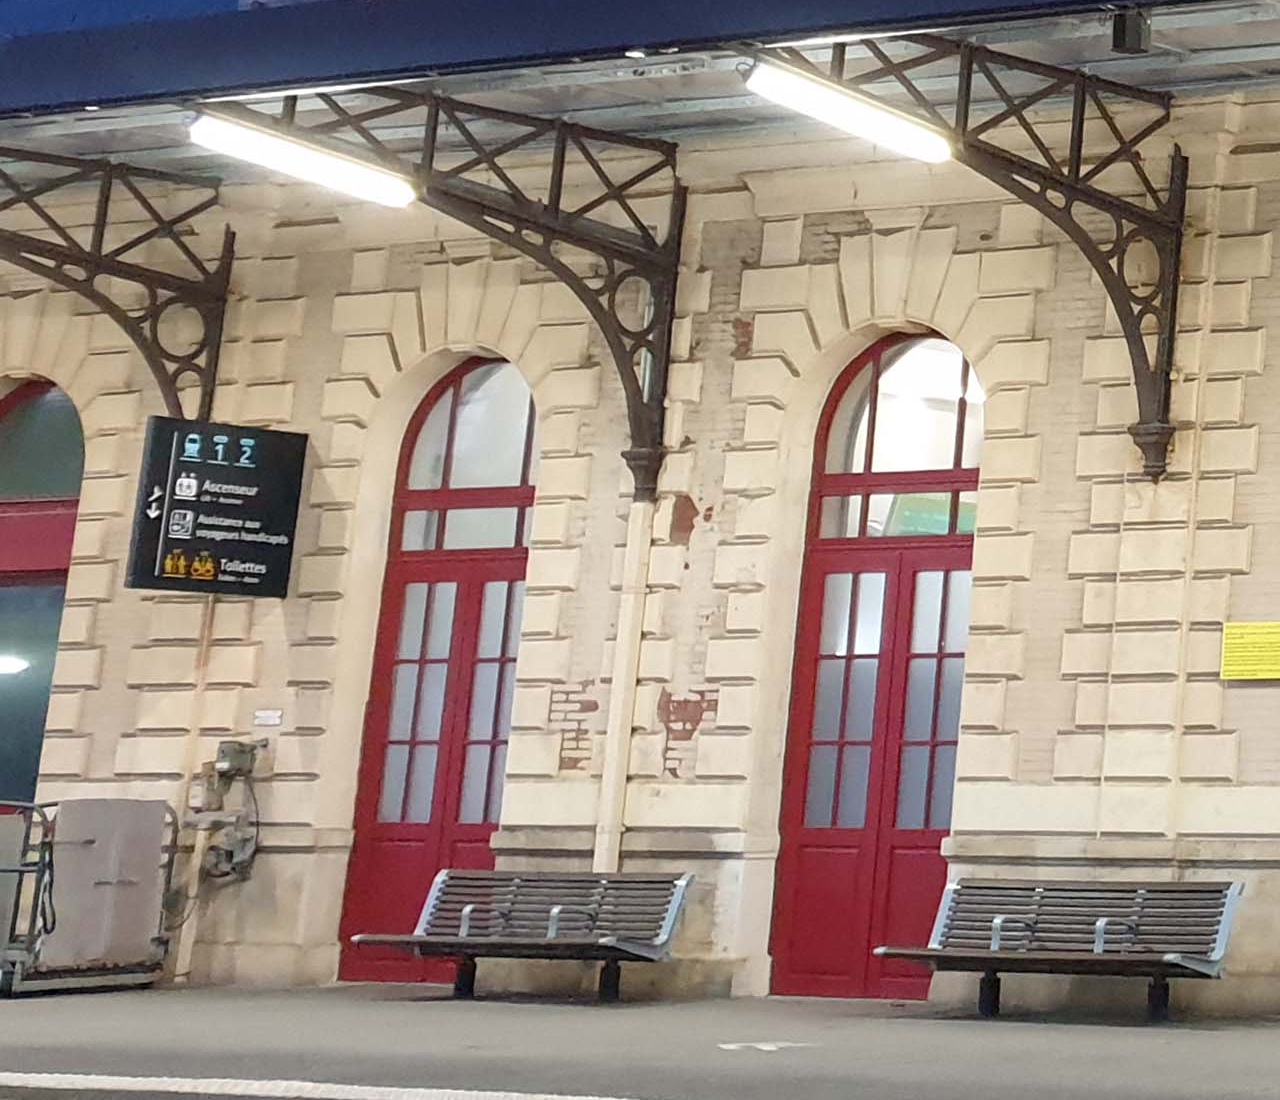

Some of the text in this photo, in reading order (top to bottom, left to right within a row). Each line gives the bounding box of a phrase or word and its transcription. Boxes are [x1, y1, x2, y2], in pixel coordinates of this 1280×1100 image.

[214, 444, 251, 464] 1 2
[202, 480, 259, 496] Ascenseur
[220, 559, 267, 574] Toilettes
